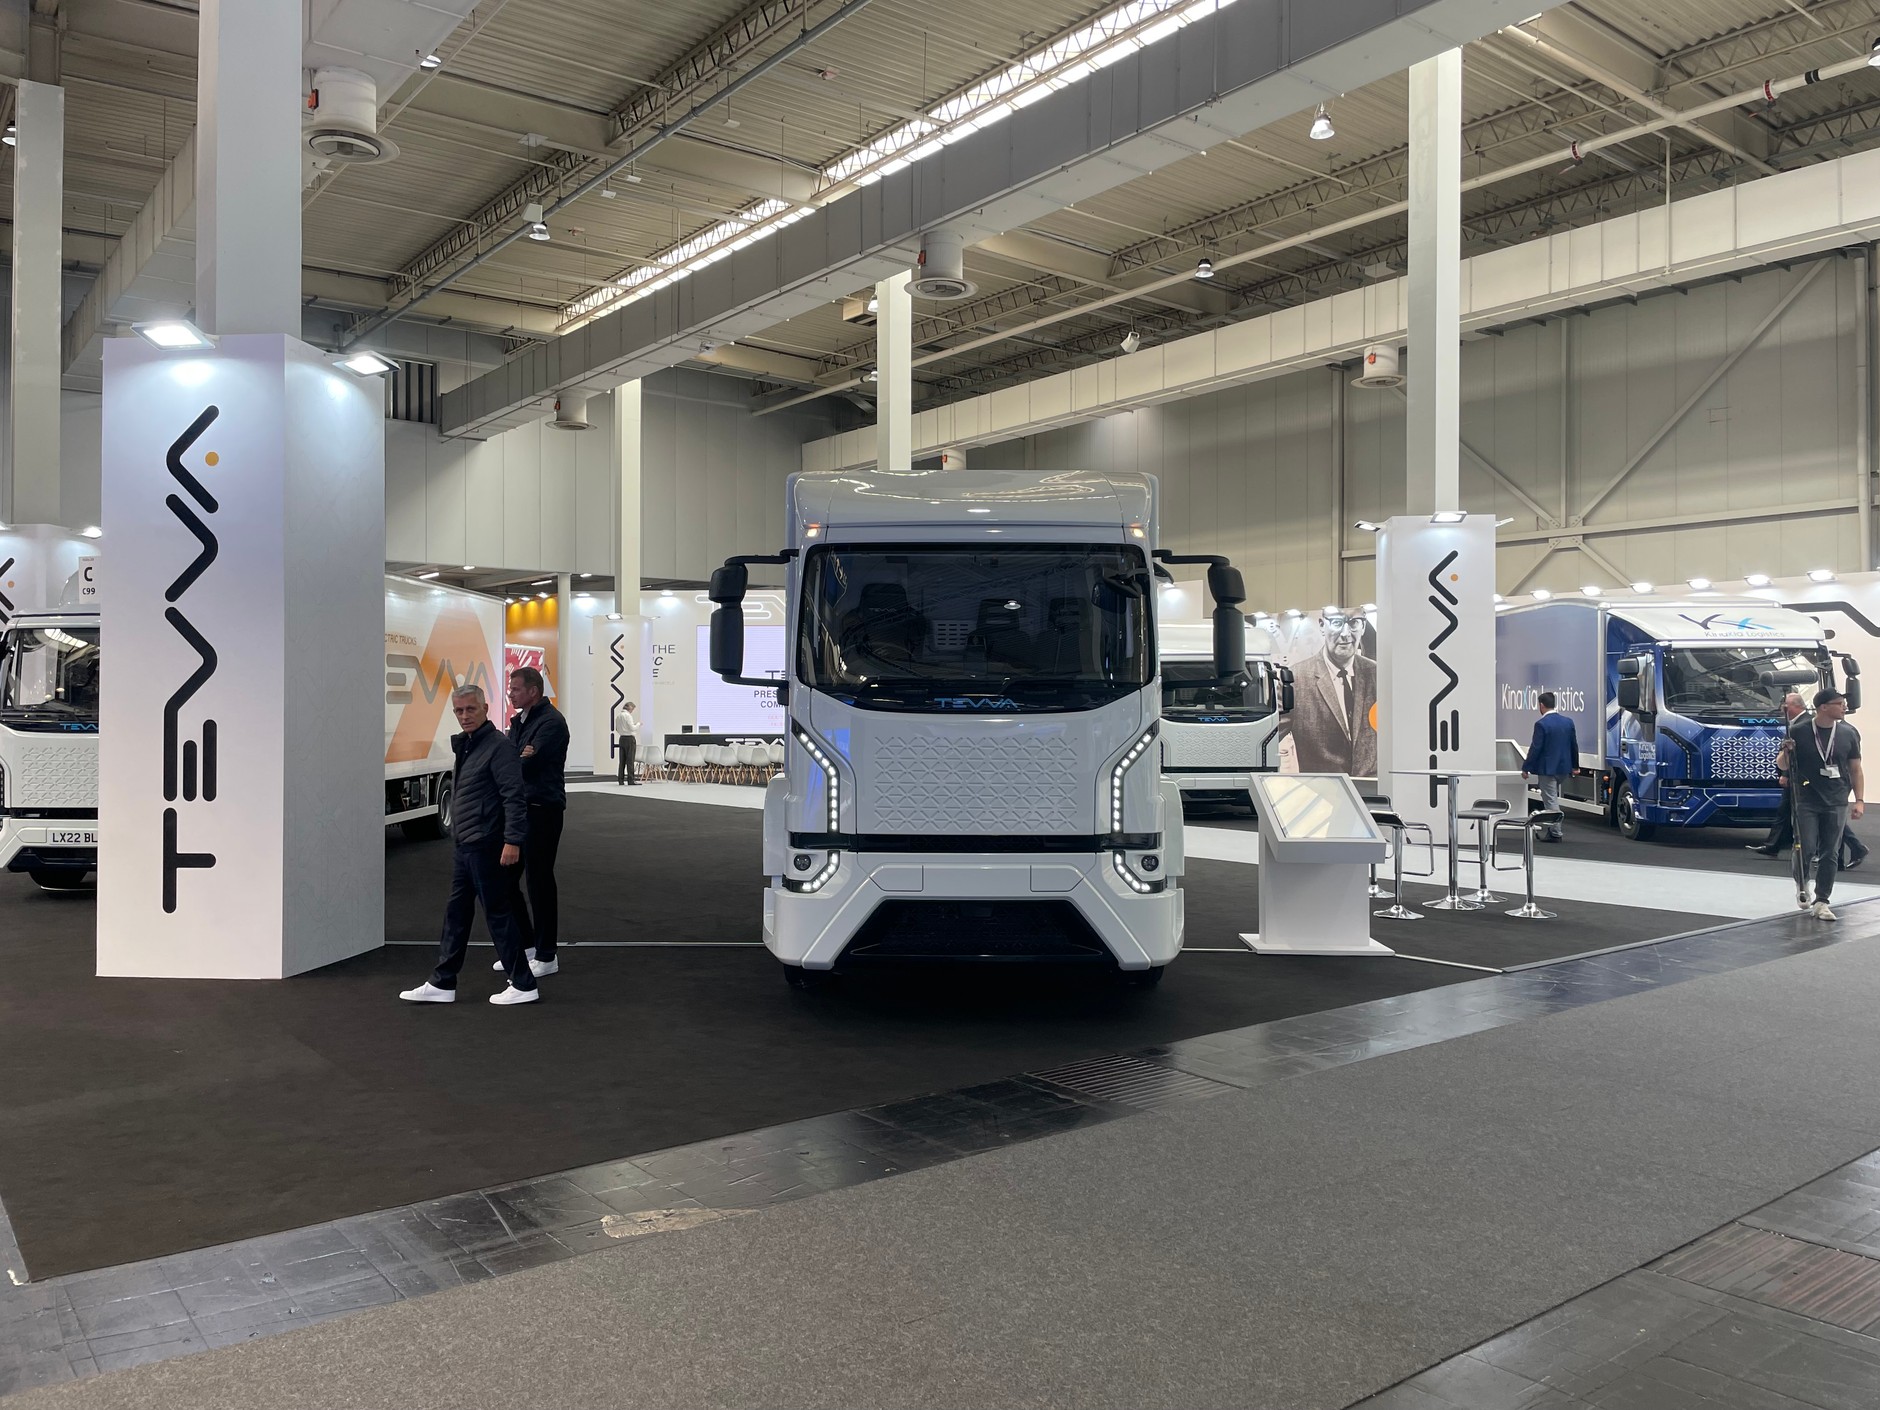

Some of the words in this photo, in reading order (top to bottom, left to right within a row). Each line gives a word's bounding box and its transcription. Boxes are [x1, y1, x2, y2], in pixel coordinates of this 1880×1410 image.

[84, 566, 93, 582] C
[82, 587, 96, 596] C99
[934, 698, 1018, 709] TEVVA
[52, 832, 81, 843] LX22
